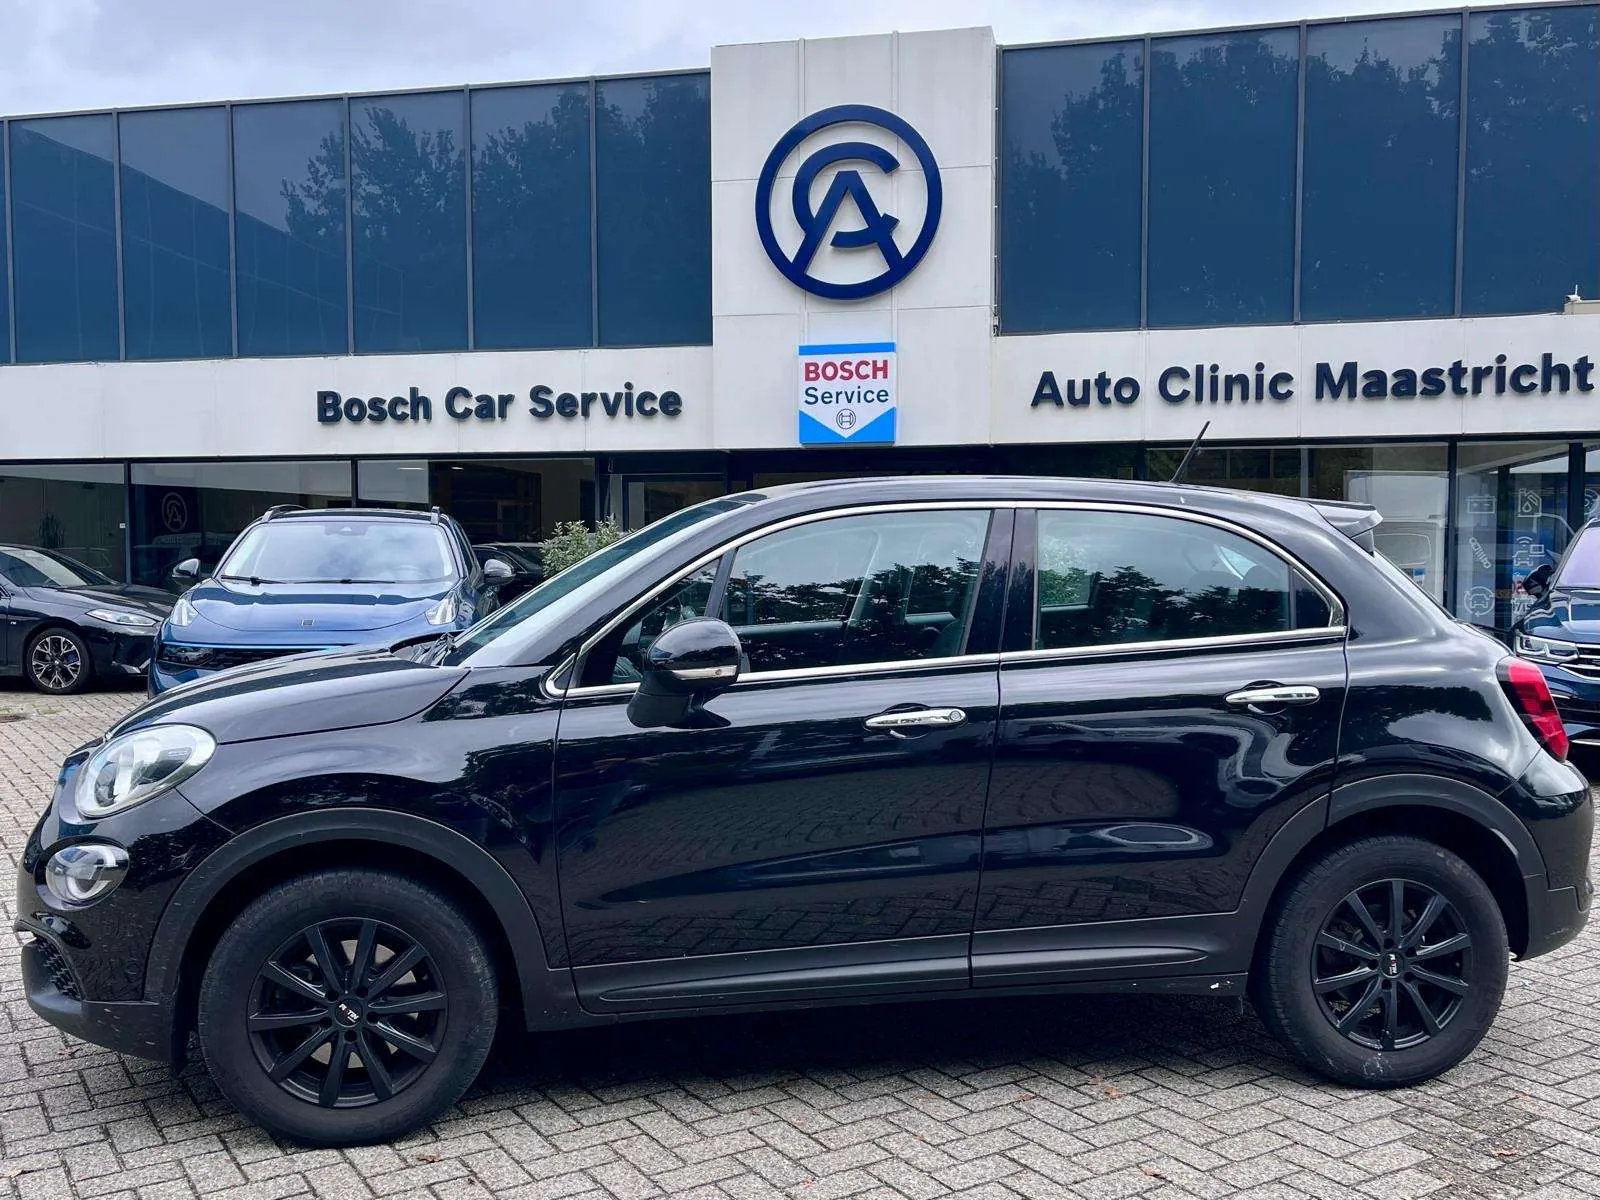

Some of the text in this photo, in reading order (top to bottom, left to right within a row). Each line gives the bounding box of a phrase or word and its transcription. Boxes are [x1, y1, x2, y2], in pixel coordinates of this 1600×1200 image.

[804, 359, 889, 382] BOSCH
[1030, 352, 1595, 410] Auto Clinic Maastricht
[316, 381, 683, 427] Bosch Car Service
[804, 385, 889, 406] Service
